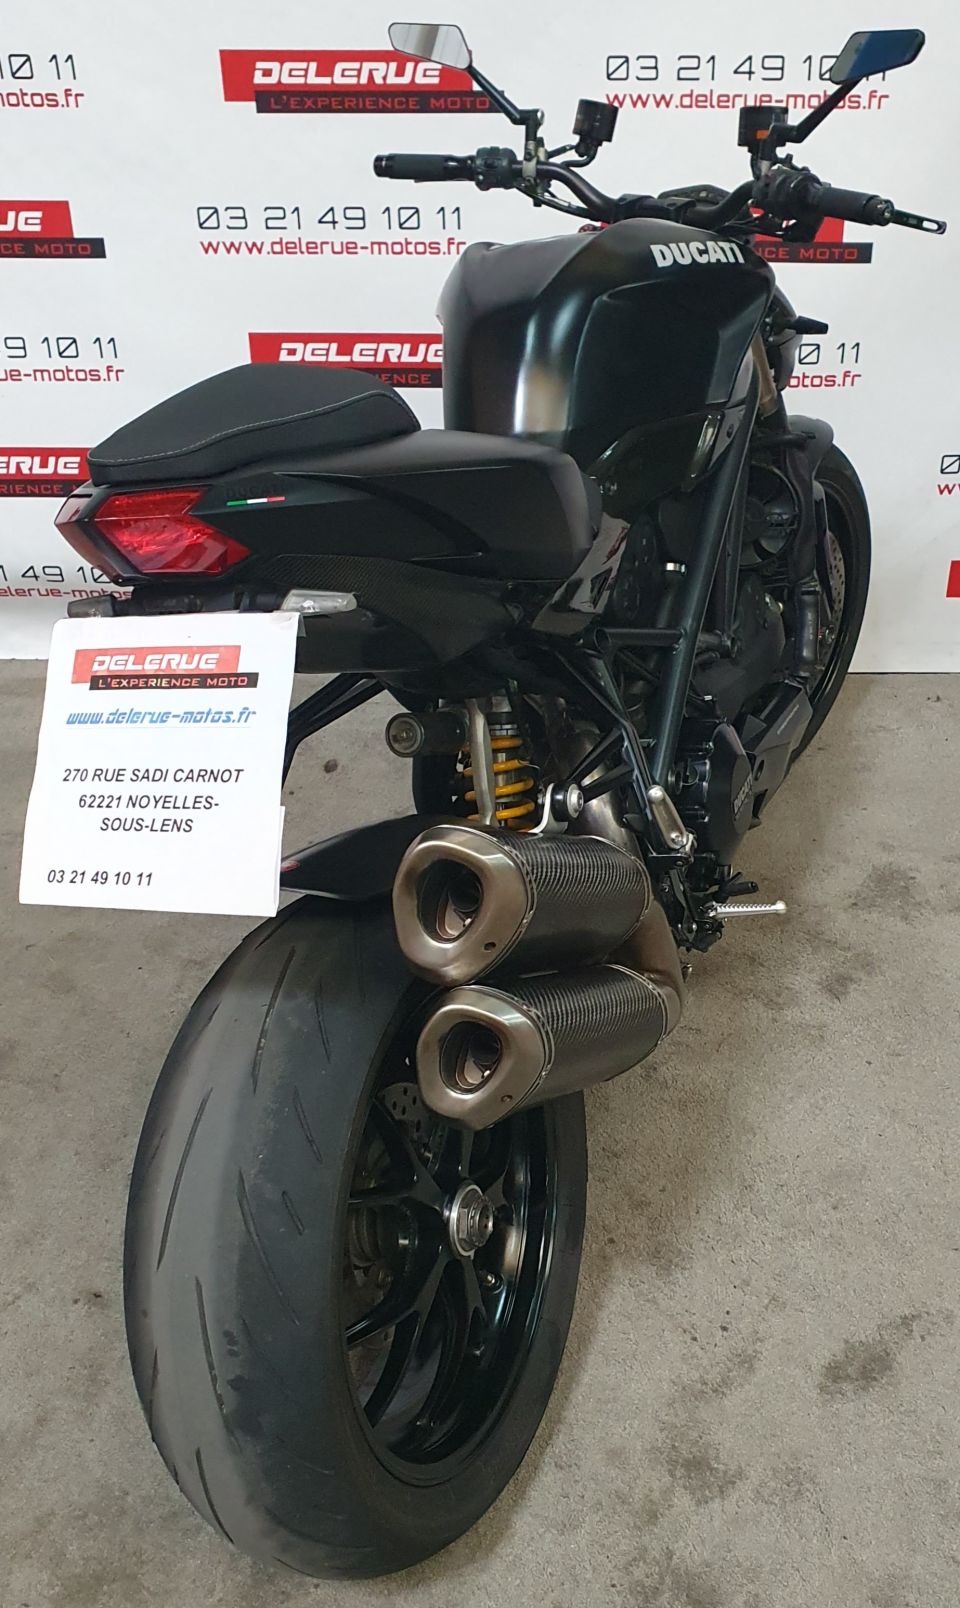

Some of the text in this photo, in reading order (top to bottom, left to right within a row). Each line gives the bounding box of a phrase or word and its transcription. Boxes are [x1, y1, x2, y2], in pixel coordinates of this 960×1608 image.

[48, 54, 76, 80] 11
[253, 61, 442, 84] DELERUE
[606, 55, 659, 81] 03
[677, 55, 715, 81] 21
[733, 55, 785, 81] 49
[270, 97, 490, 109] L'EXPERIENCE MOTO
[197, 206, 461, 230] 03 21 49 10 11
[34, 243, 92, 255] MOTO
[200, 237, 467, 256] www.delerue-motos.fr
[649, 241, 745, 268] DUCATI
[800, 248, 857, 259] MOTO
[4, 336, 117, 359] 9 10 11
[279, 342, 443, 363] DELERUE
[836, 342, 860, 364] 11
[787, 370, 862, 388] otos.fr
[937, 484, 960, 495] w
[21, 565, 65, 583] 49
[91, 653, 220, 671] DELERUE
[98, 677, 248, 688] L'EXPERIENCE MOTO
[66, 706, 256, 725] www.delerue-motos.fr
[62, 768, 244, 783] 270 RUE SADI CARNOT
[78, 794, 220, 810] 62221 NOYELLES-
[99, 817, 194, 833] SOUS-LENS
[47, 869, 153, 886] 03 21 49 10 11
